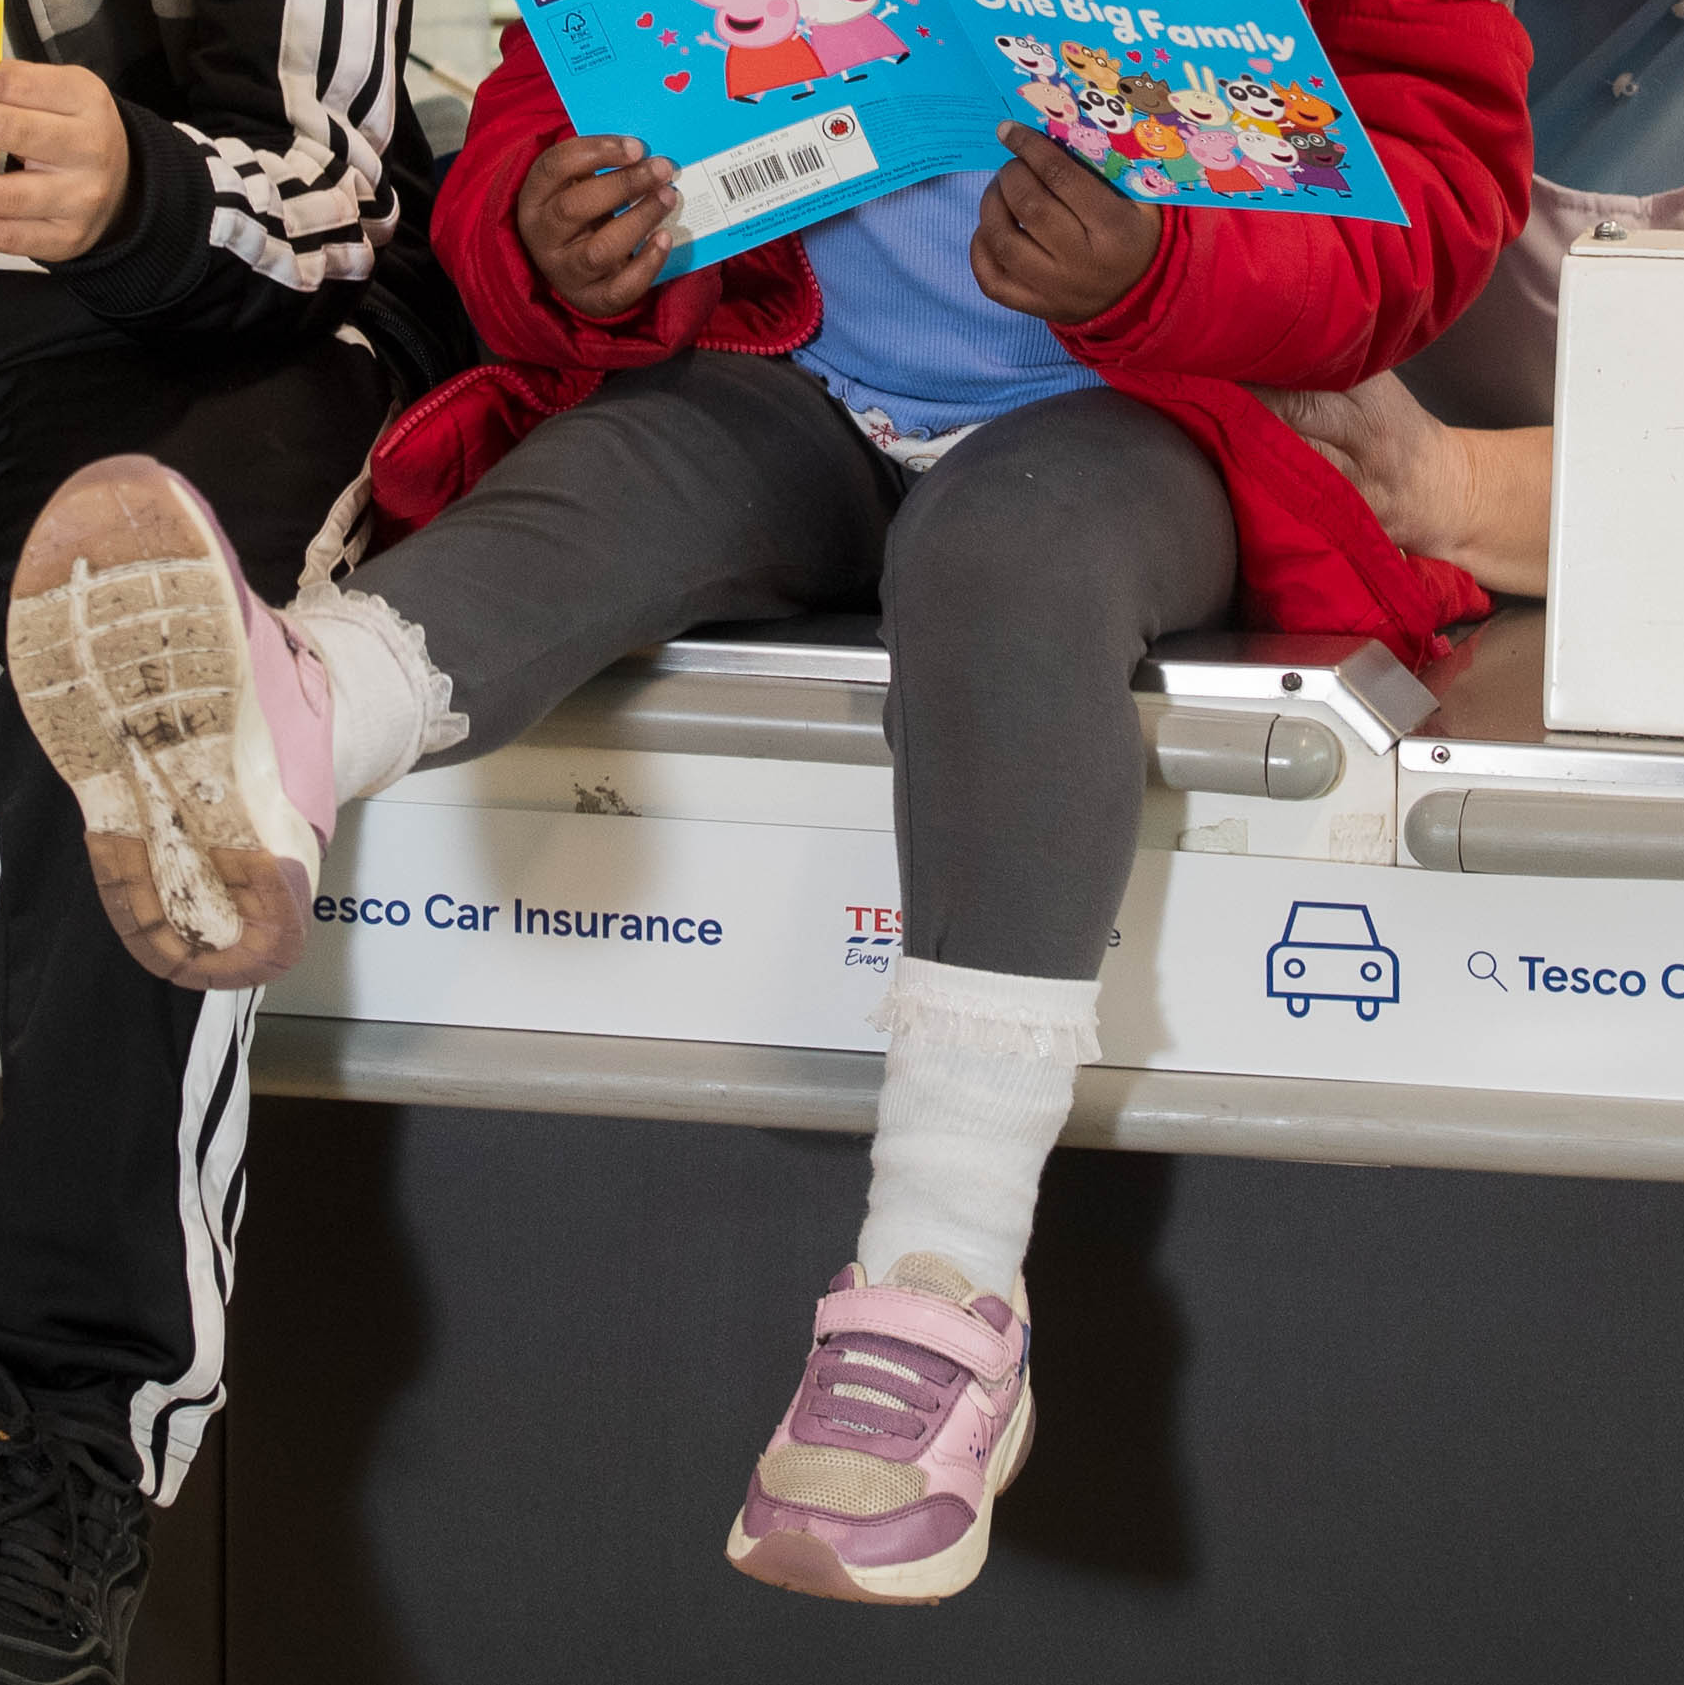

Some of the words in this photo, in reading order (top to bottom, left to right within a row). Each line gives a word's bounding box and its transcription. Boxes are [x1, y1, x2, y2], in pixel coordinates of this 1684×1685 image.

[1138, 9, 1296, 63] Family
[424, 893, 500, 932] Car
[514, 898, 724, 947] Insurance
[844, 947, 890, 974] Every
[1518, 954, 1647, 998] Tesco
